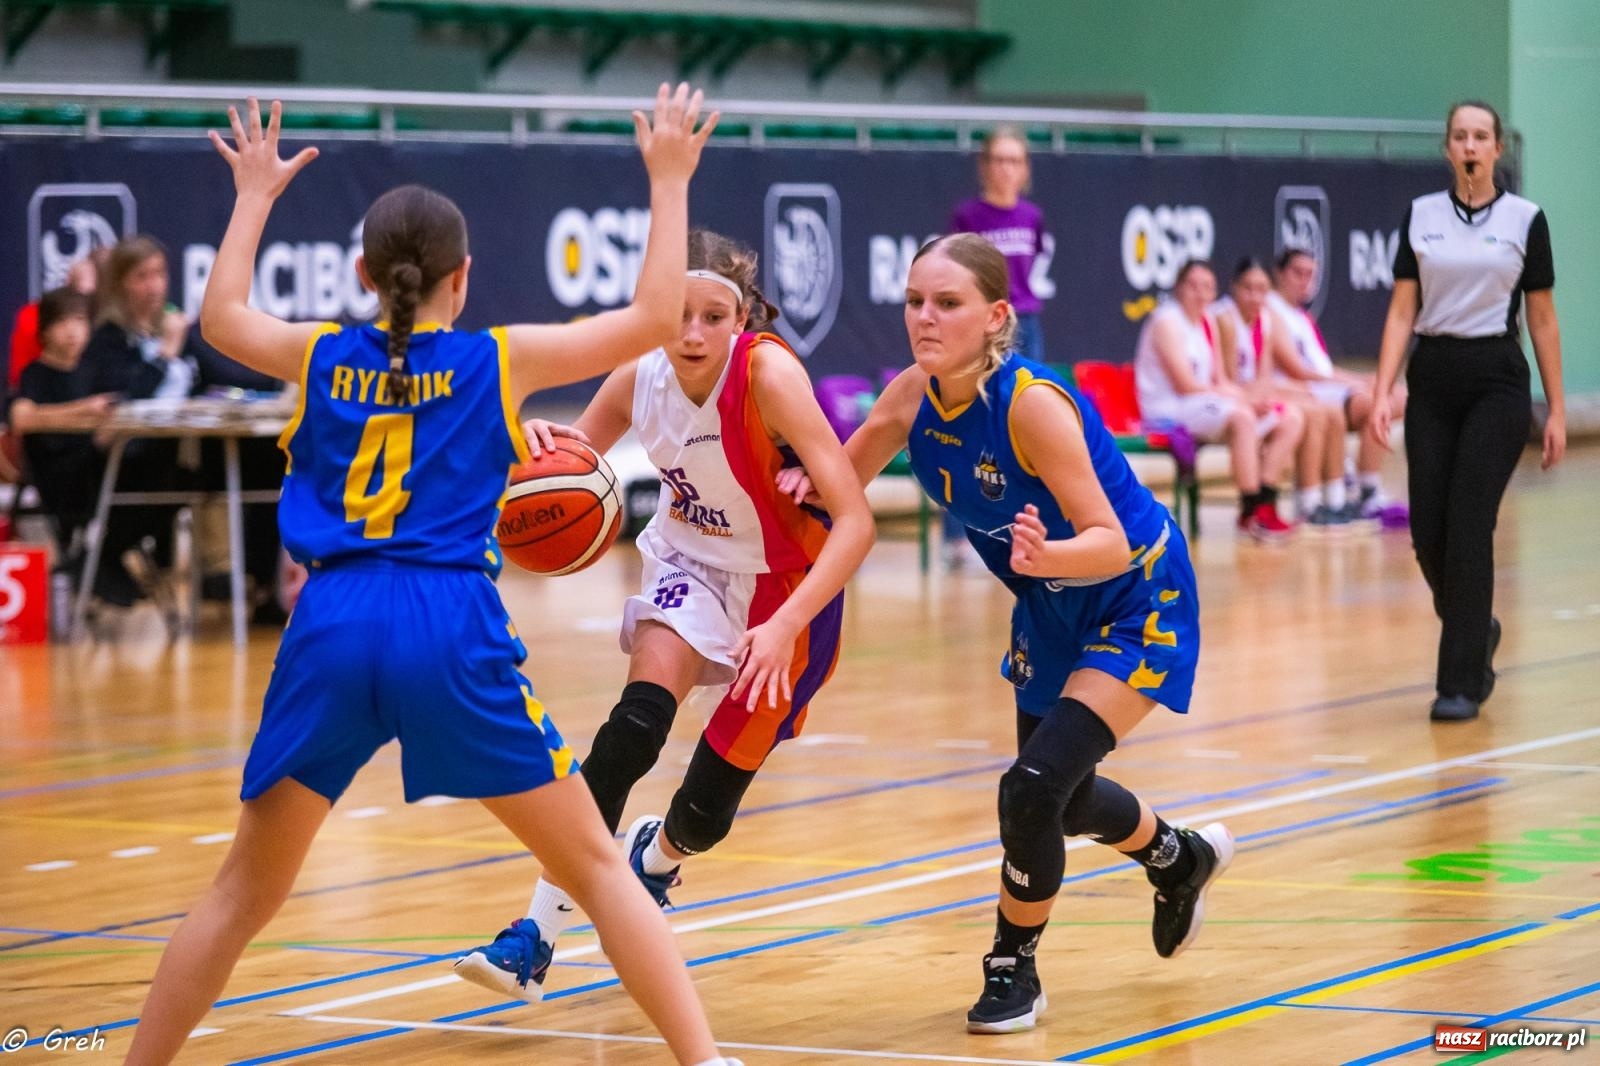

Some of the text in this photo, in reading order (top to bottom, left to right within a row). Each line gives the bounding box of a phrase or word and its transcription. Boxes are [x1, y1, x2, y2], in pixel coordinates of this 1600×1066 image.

[343, 413, 414, 539] 4
[0, 553, 30, 623] 5
[1010, 865, 1029, 888] NBA
